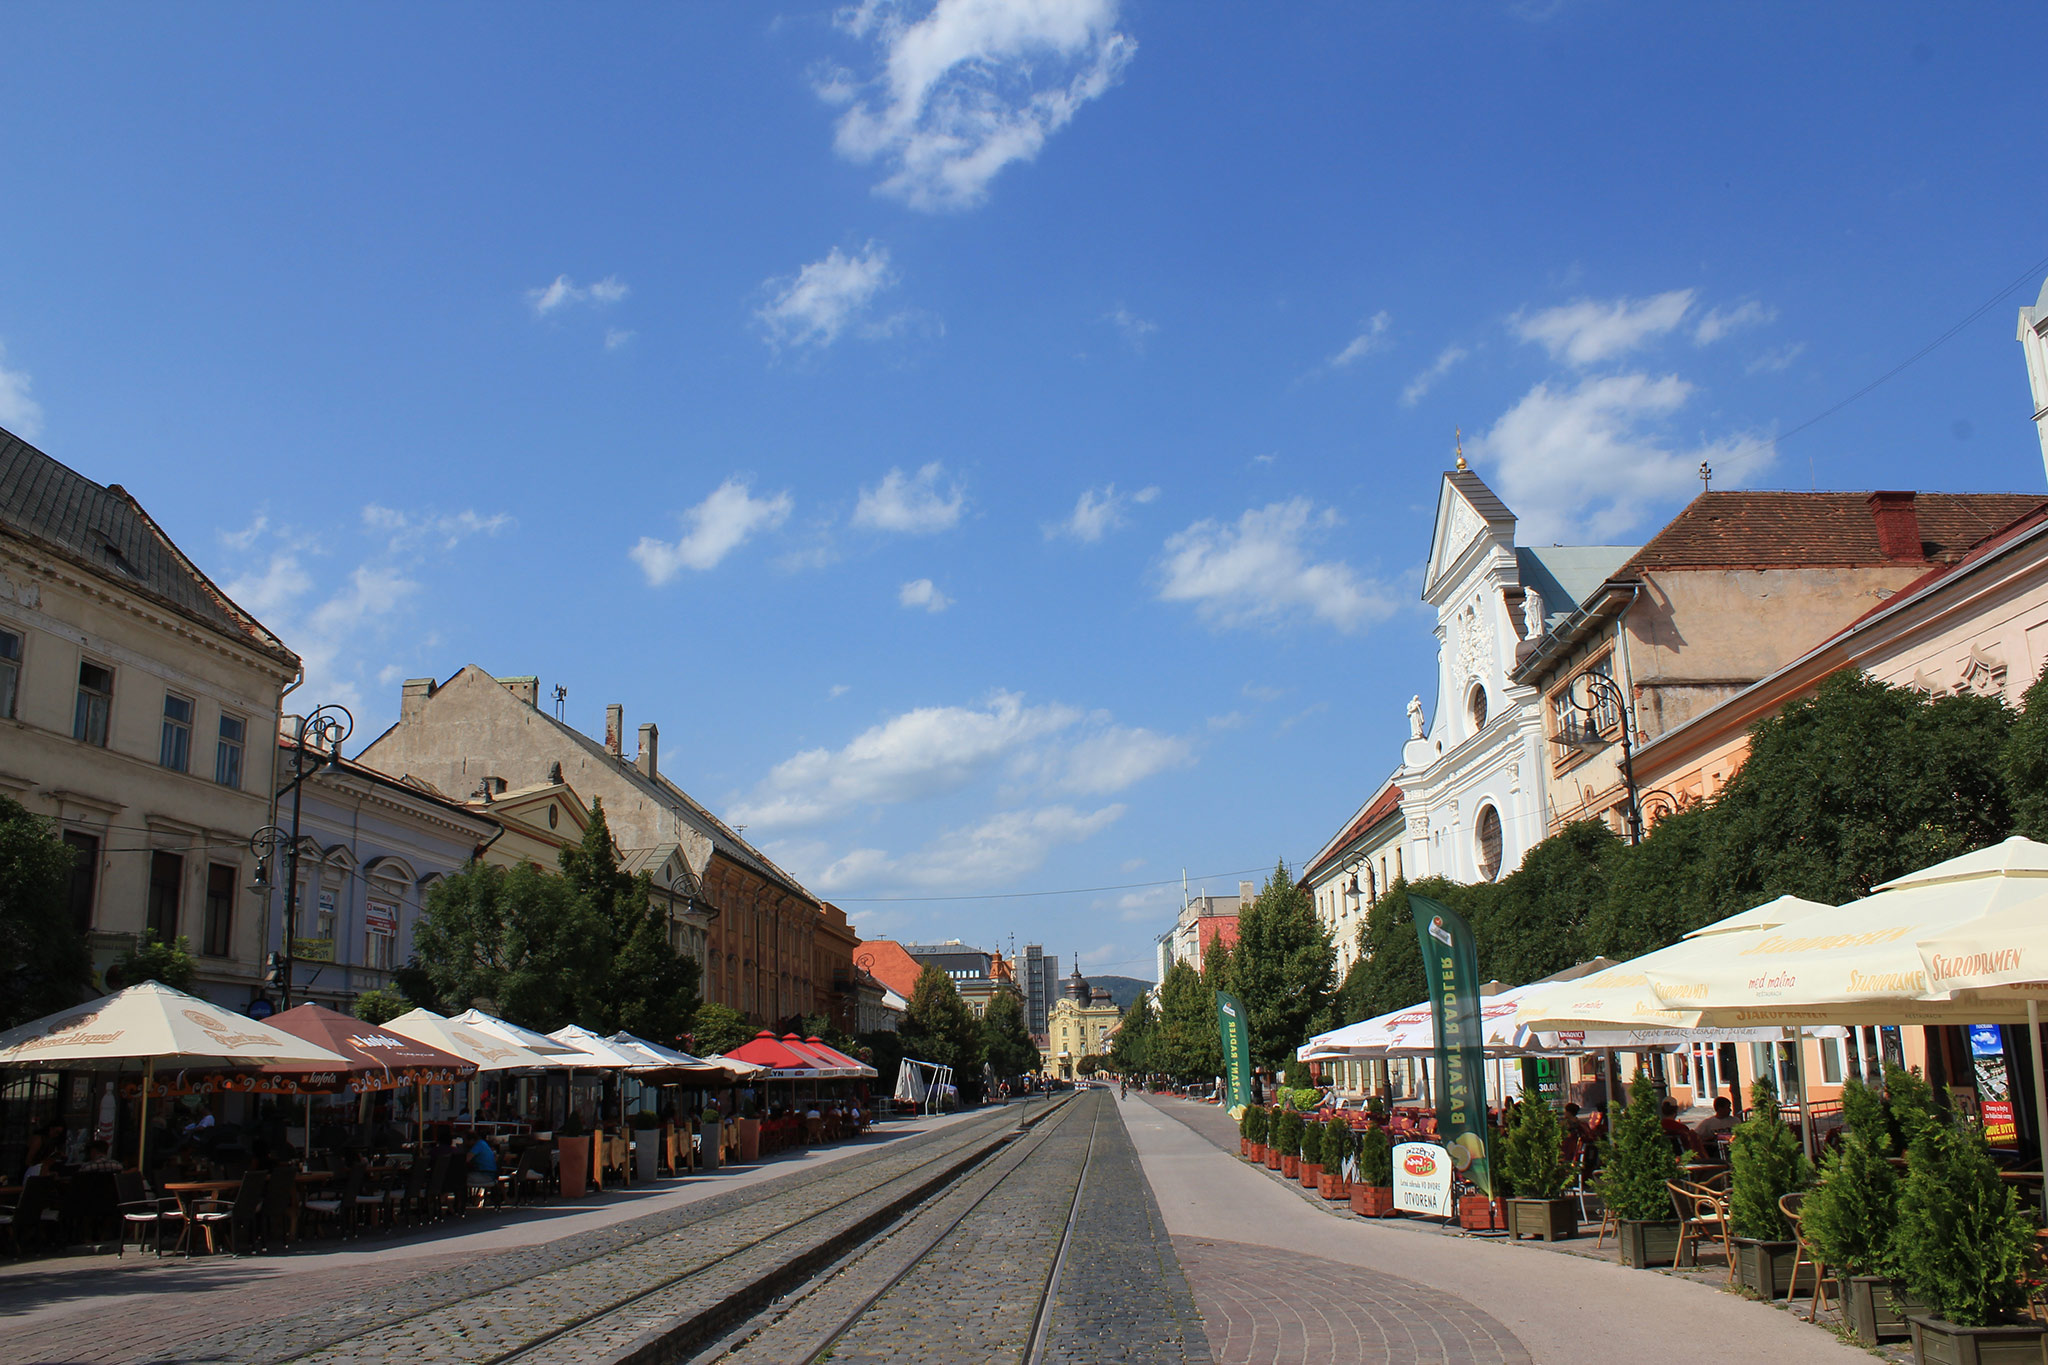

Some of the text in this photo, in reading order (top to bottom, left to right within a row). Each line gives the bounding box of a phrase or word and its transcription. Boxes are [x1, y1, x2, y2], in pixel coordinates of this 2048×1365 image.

[1932, 947, 2023, 982] STAROPRAMEN
[1748, 970, 1796, 990] med malina
[1846, 968, 1926, 993] STAROPRAME
[308, 1072, 337, 1087] kofola
[2000, 1122, 2015, 1134] BYTY
[1404, 1191, 1438, 1209] OTVORENÁ
